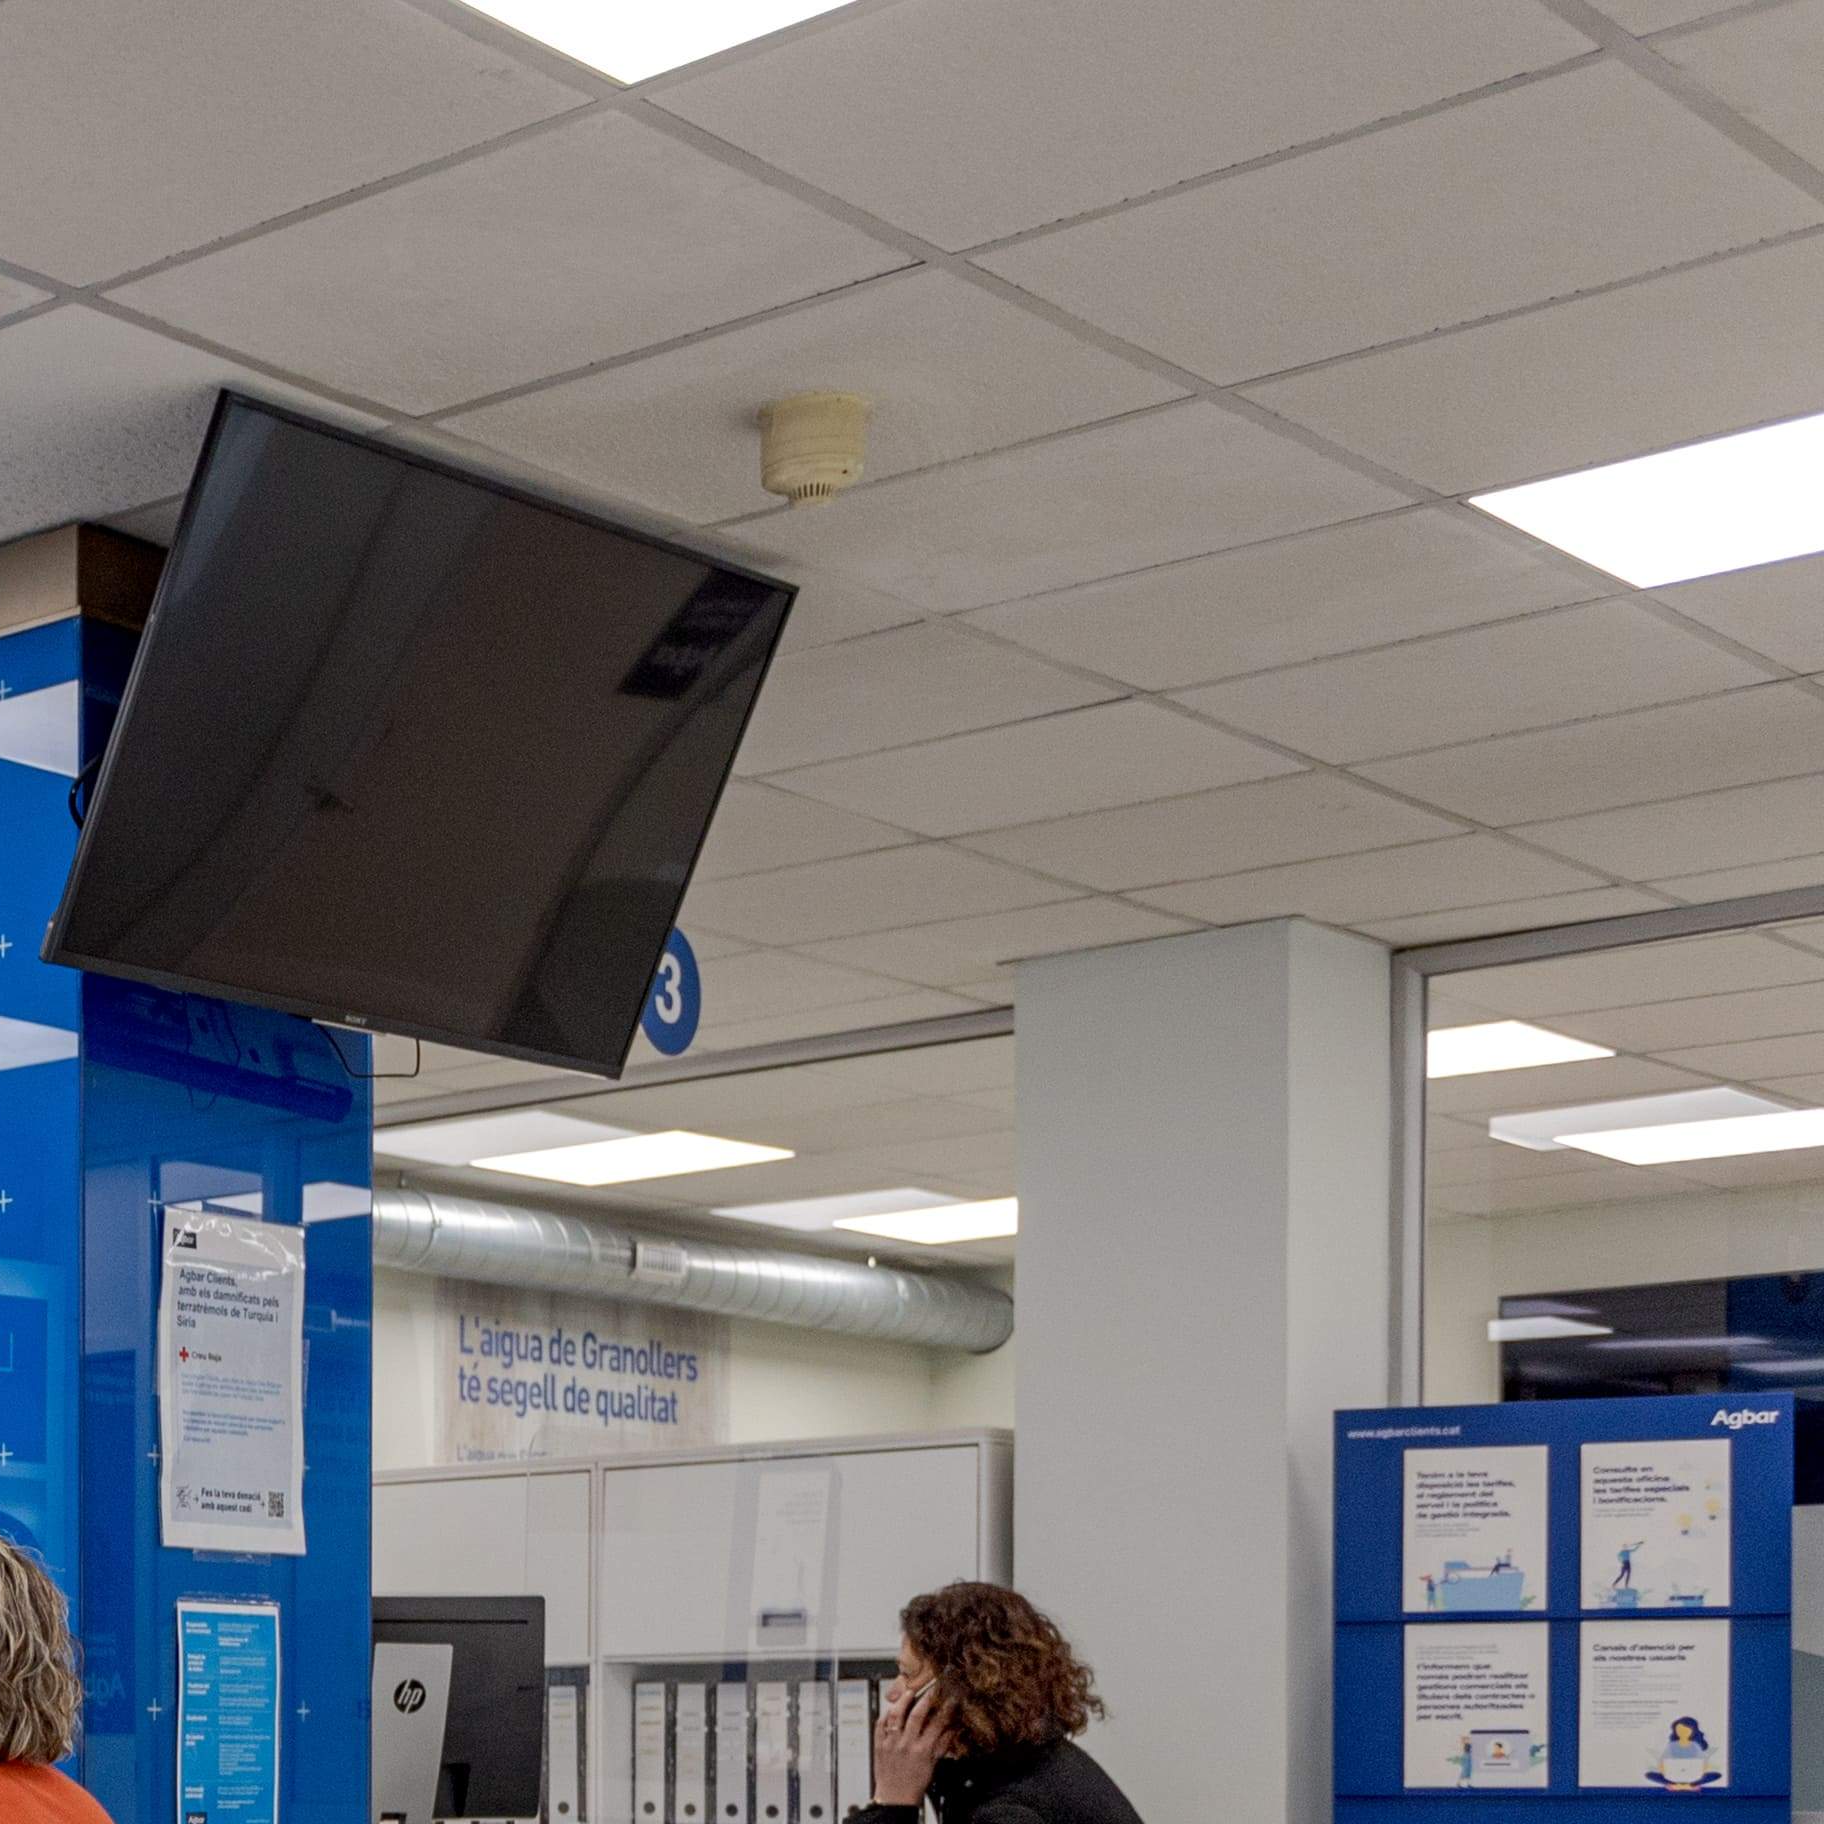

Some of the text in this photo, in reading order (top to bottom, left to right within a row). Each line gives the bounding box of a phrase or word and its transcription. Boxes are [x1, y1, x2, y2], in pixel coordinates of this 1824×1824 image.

[655, 952, 681, 1023] 3
[179, 1268, 205, 1283] Agbar
[178, 1285, 279, 1309] amb els damnificats pels
[177, 1301, 228, 1317] terratrèmols
[230, 1308, 240, 1318] de
[243, 1308, 274, 1323] Turquia
[459, 1315, 698, 1383] L'aigua de Granollers
[458, 1361, 678, 1426] té segell de qualitat
[1711, 1408, 1780, 1430] Agbar
[201, 1488, 212, 1497] Fes
[222, 1489, 236, 1499] teva
[201, 1503, 214, 1511] amb
[216, 1503, 238, 1514] aquest
[397, 1679, 423, 1714] hp
